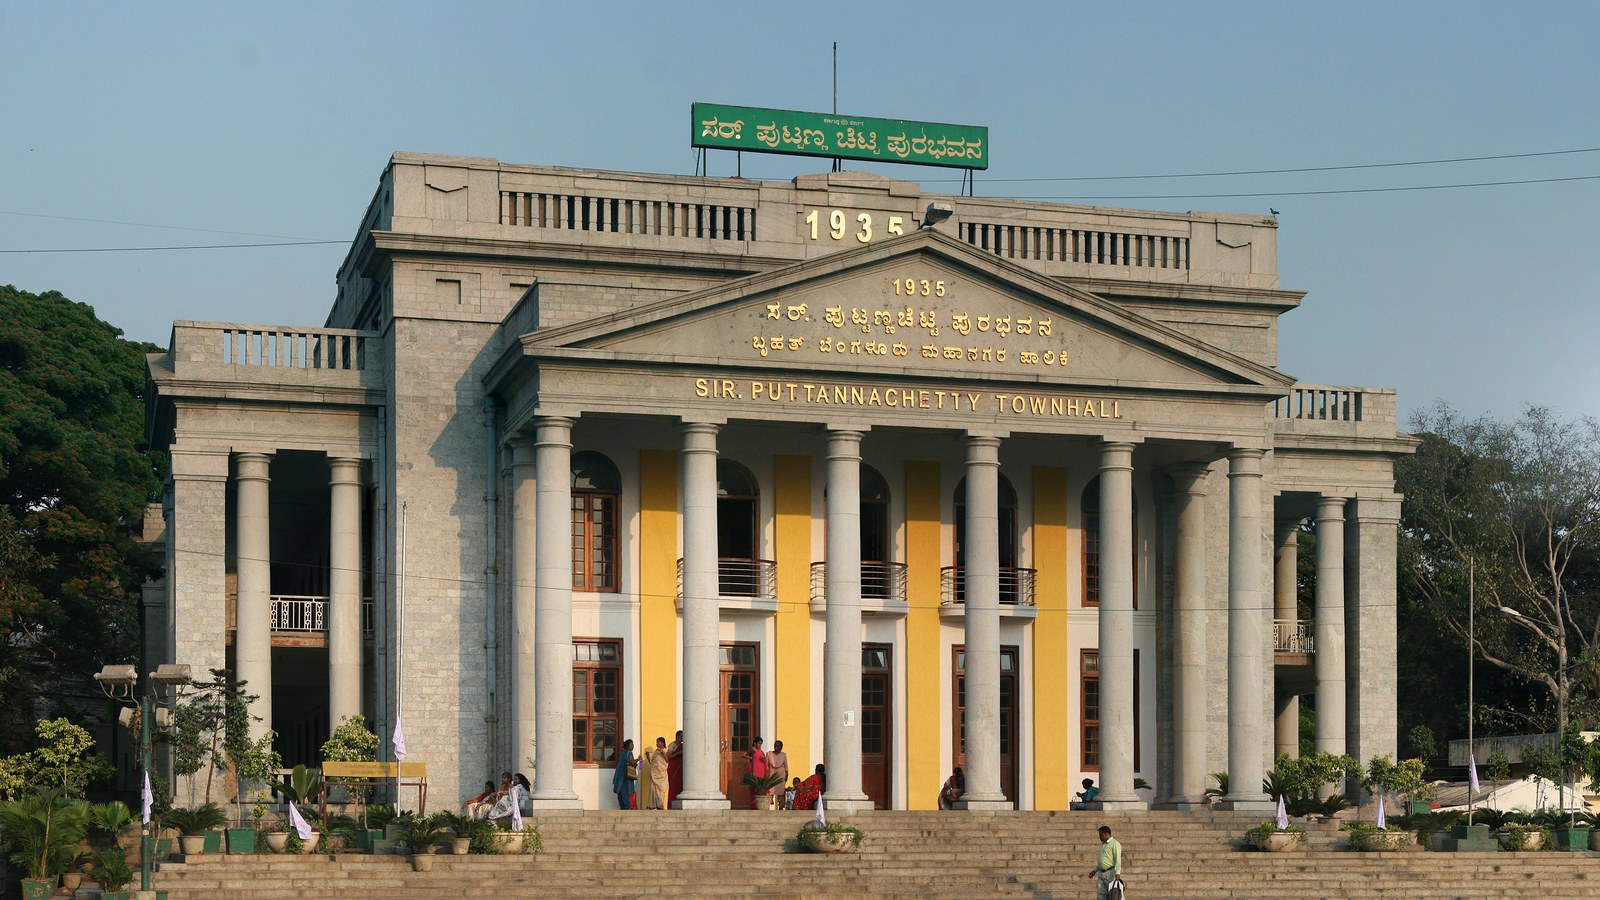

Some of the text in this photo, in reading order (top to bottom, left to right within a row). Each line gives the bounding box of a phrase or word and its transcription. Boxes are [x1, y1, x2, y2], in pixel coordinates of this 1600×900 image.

[756, 121, 829, 150] ಪುಟ್ಟಣ್ಣ
[836, 127, 880, 155] ಚೆಟ್ಟಿ
[887, 131, 982, 159] ಪುರಭವನ
[805, 210, 903, 243] 1935
[893, 278, 945, 297] 1935
[952, 312, 1052, 338] ಪುರಭವನ
[752, 335, 1069, 367] ಬೃಹತ್ ಬೆಂಗಳೂರು ಮಹಾನಗರ ಪಾಲಿಕೆ
[695, 378, 1121, 419] SIR. PUTTANNACHETTY TOWNHALL
